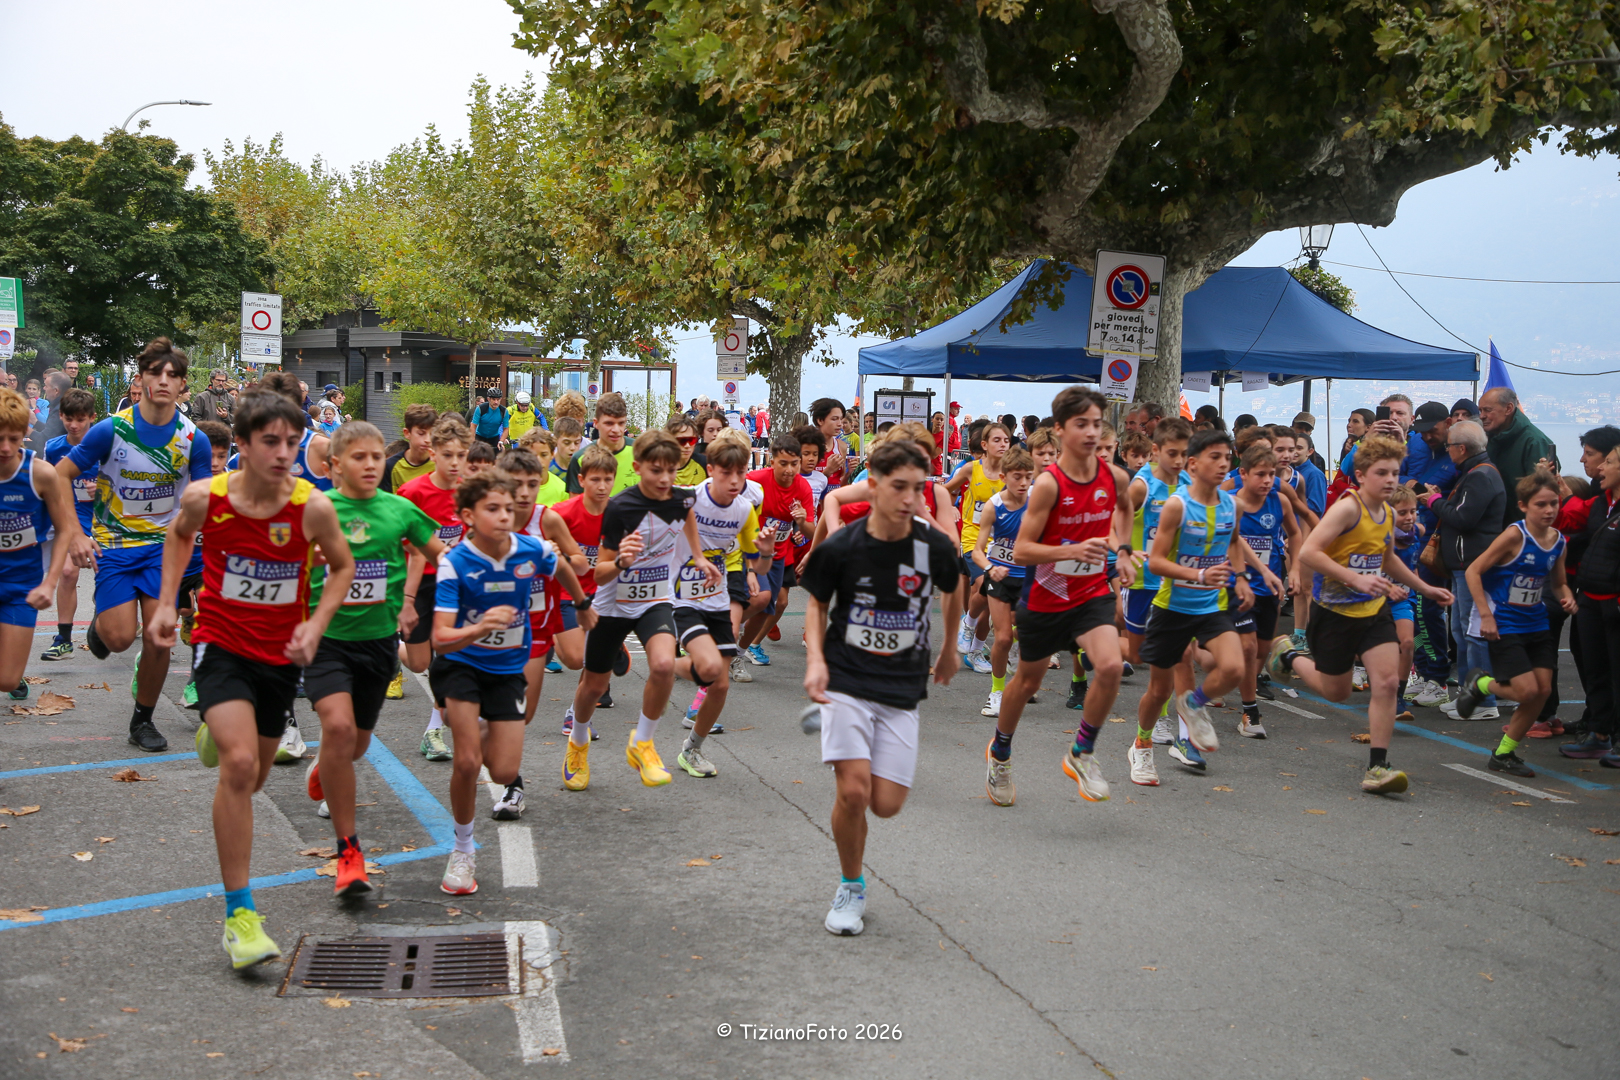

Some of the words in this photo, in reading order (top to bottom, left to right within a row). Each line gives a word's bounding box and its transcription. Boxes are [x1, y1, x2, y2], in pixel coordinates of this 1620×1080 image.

[1094, 322, 1110, 330] per
[1113, 324, 1154, 334] mercato
[465, 381, 501, 389] BSTROT
[144, 501, 153, 513] 4
[0, 533, 23, 548] 59
[238, 579, 282, 602] 247
[627, 584, 657, 599] 351
[480, 631, 506, 645] 25
[860, 629, 899, 650] 388
